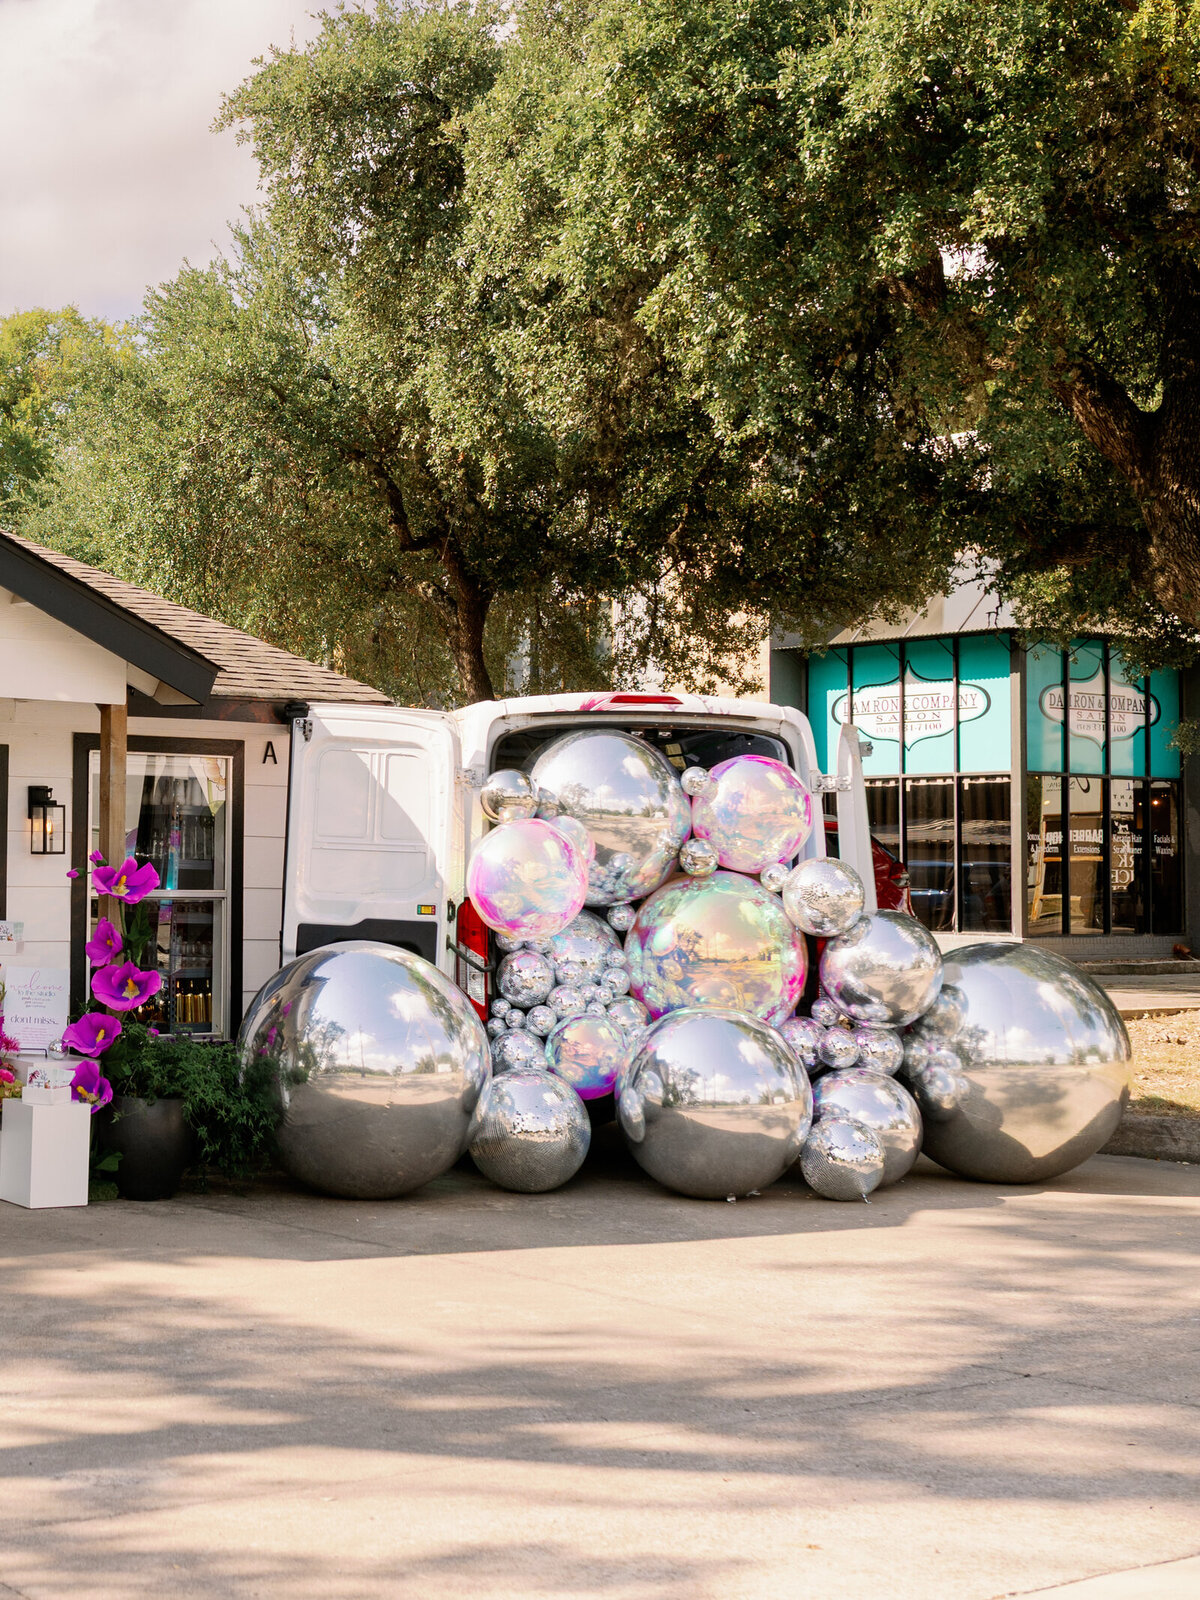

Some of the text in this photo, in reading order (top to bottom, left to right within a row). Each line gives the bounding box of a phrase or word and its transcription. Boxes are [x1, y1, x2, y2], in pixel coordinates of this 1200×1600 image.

[843, 698, 899, 714] DAMRON
[912, 693, 978, 710] COMPANY
[1049, 693, 1152, 713] DARON & OMPAN
[876, 711, 942, 722] SALON
[1076, 711, 1126, 721] SALON
[901, 723, 942, 732] 31-7100
[262, 741, 277, 764] A
[1131, 833, 1142, 843] Hair
[1153, 834, 1176, 843] Facials &
[1073, 844, 1100, 853] Extensions
[1155, 845, 1174, 857] Waxing
[10, 970, 64, 991] welcome
